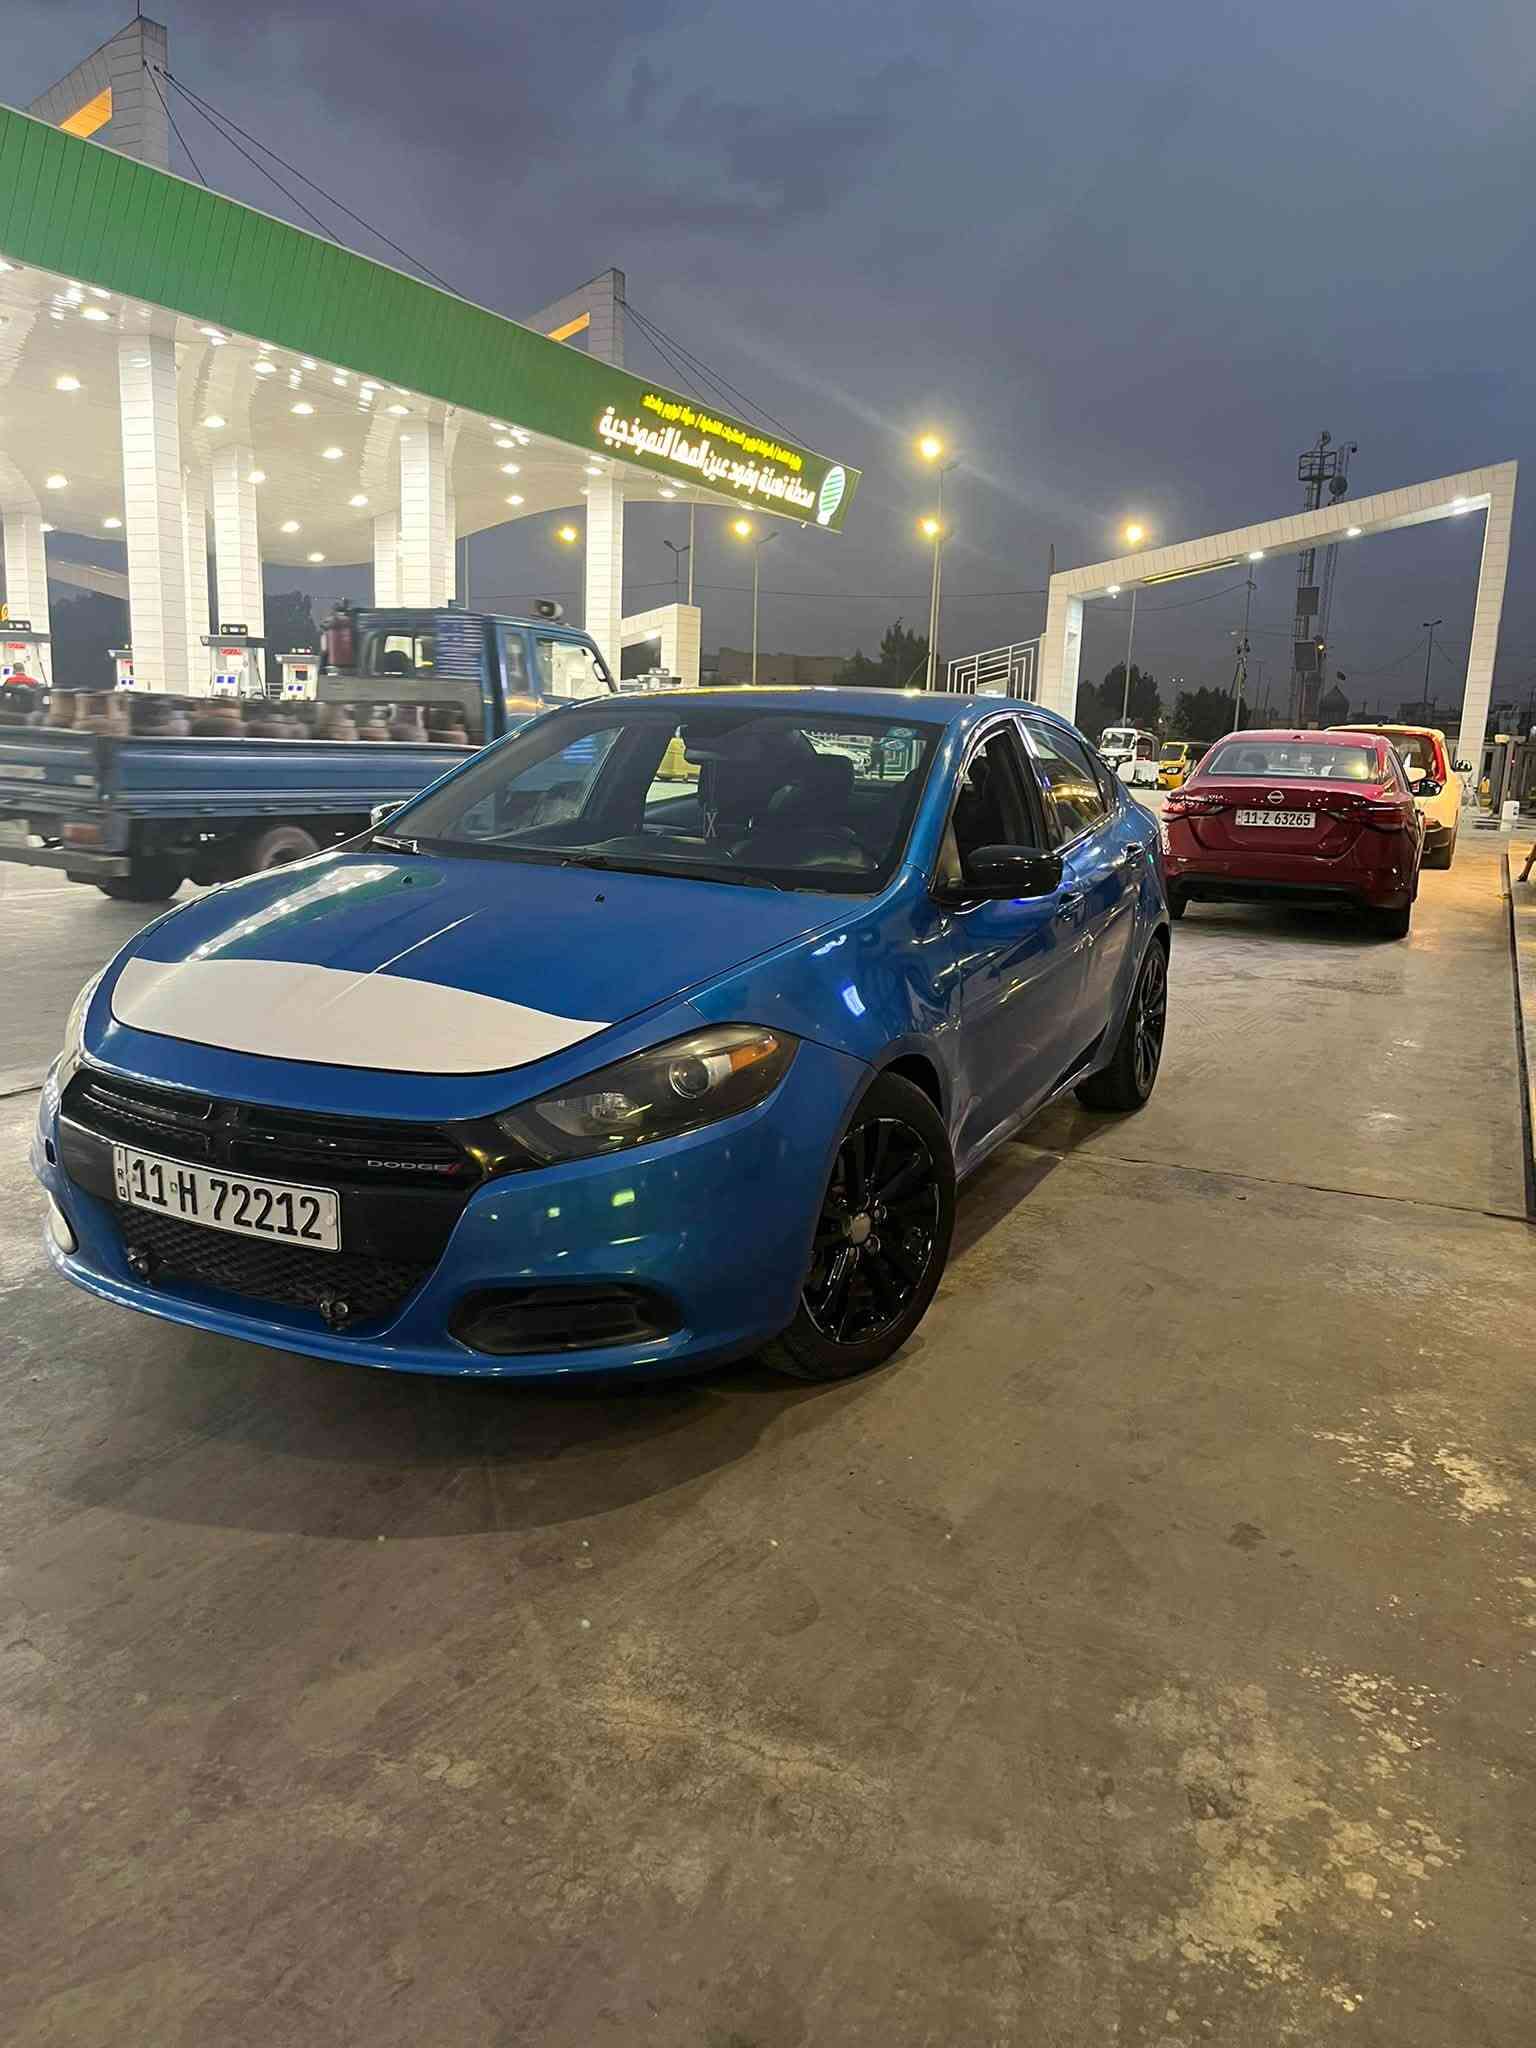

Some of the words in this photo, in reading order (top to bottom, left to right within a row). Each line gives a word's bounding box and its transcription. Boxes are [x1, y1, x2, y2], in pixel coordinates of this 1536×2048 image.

[599, 405, 677, 457] النموذجية
[669, 429, 711, 470] المها
[702, 450, 730, 481] عين
[727, 460, 760, 495] وقود
[757, 466, 789, 500] تعبئة
[784, 476, 816, 509] محطة
[1274, 812, 1310, 826] 63265
[367, 1159, 451, 1172] DODGE
[132, 1158, 168, 1207] 11
[209, 1178, 322, 1241] 72212
